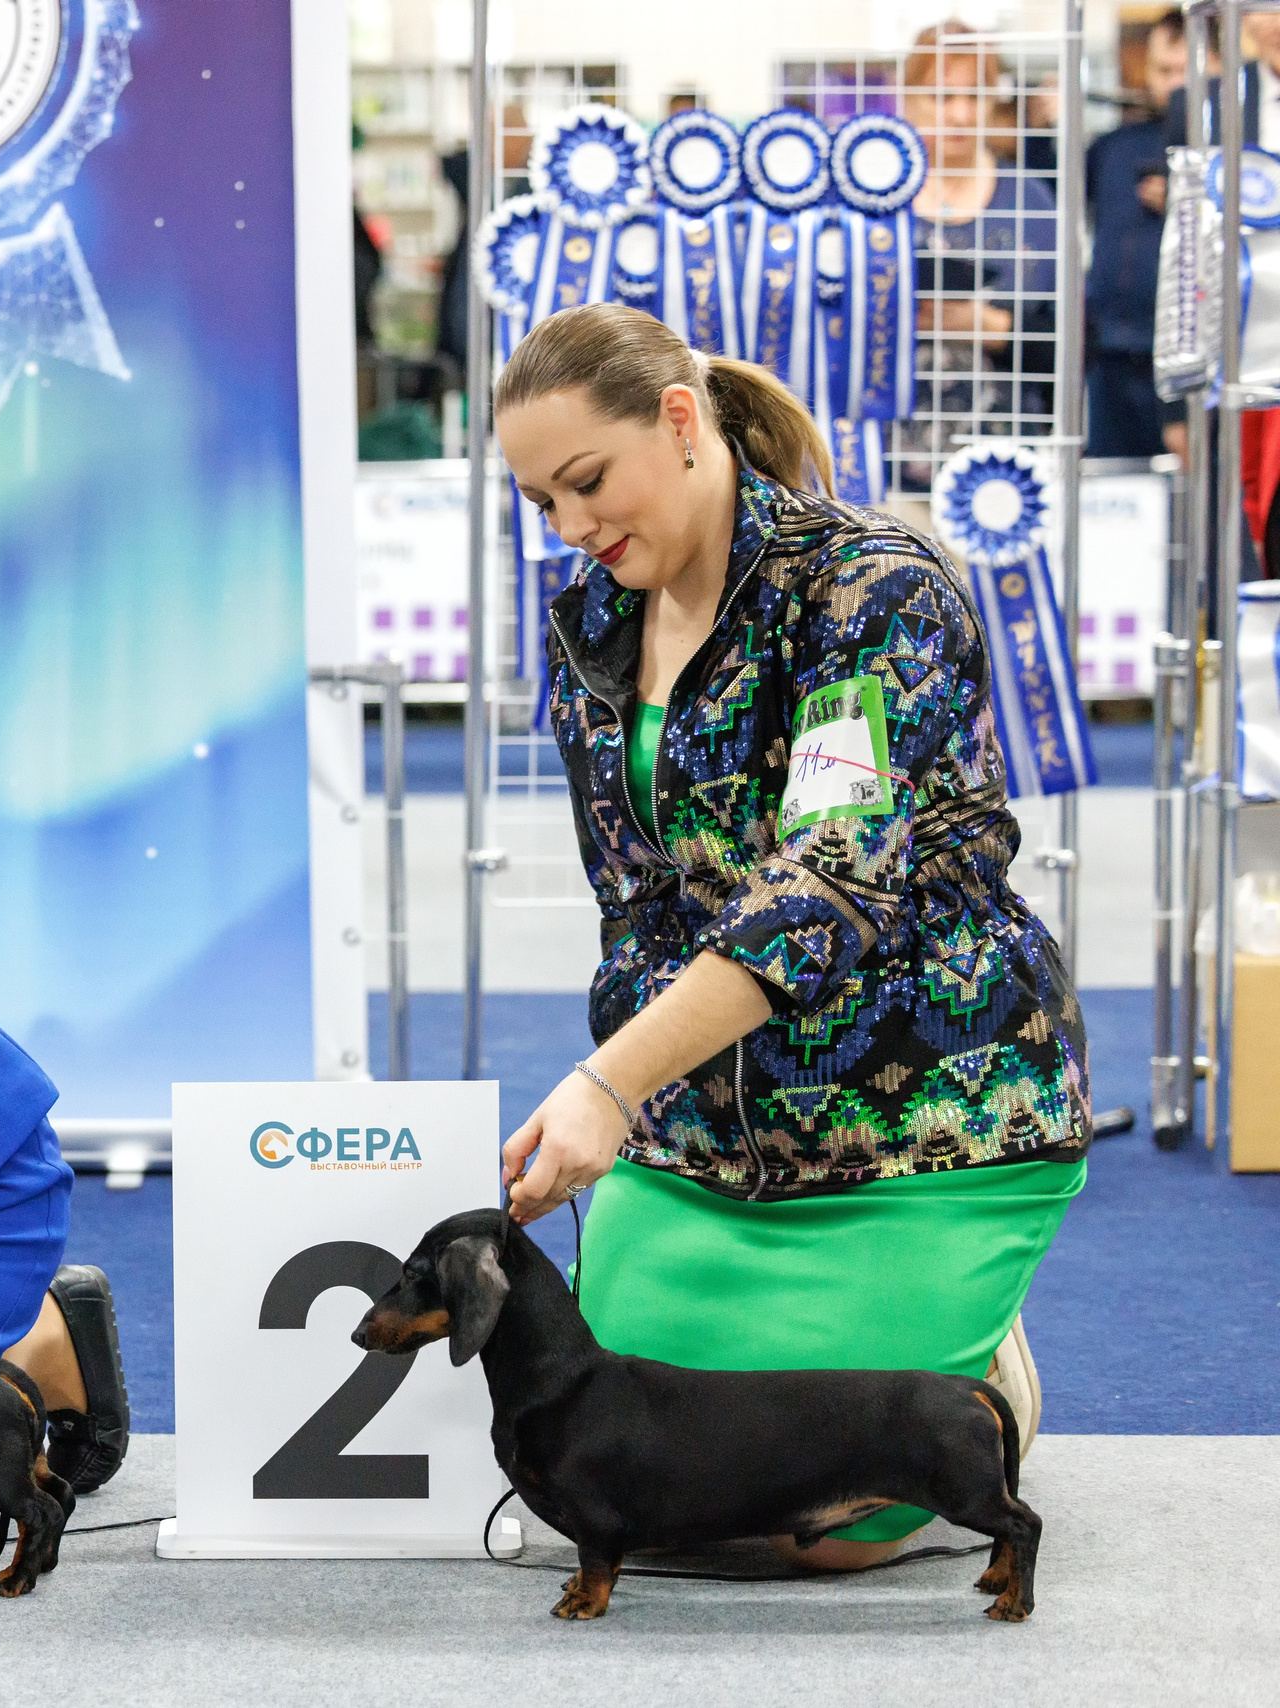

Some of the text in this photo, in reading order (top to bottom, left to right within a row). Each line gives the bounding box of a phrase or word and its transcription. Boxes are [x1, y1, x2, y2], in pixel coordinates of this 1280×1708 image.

[250, 1121, 422, 1169] СФЕРА
[310, 1161, 423, 1171] ВЫСТАВОЧНЫЙ ЦЕНТР
[252, 1240, 430, 1499] 2
